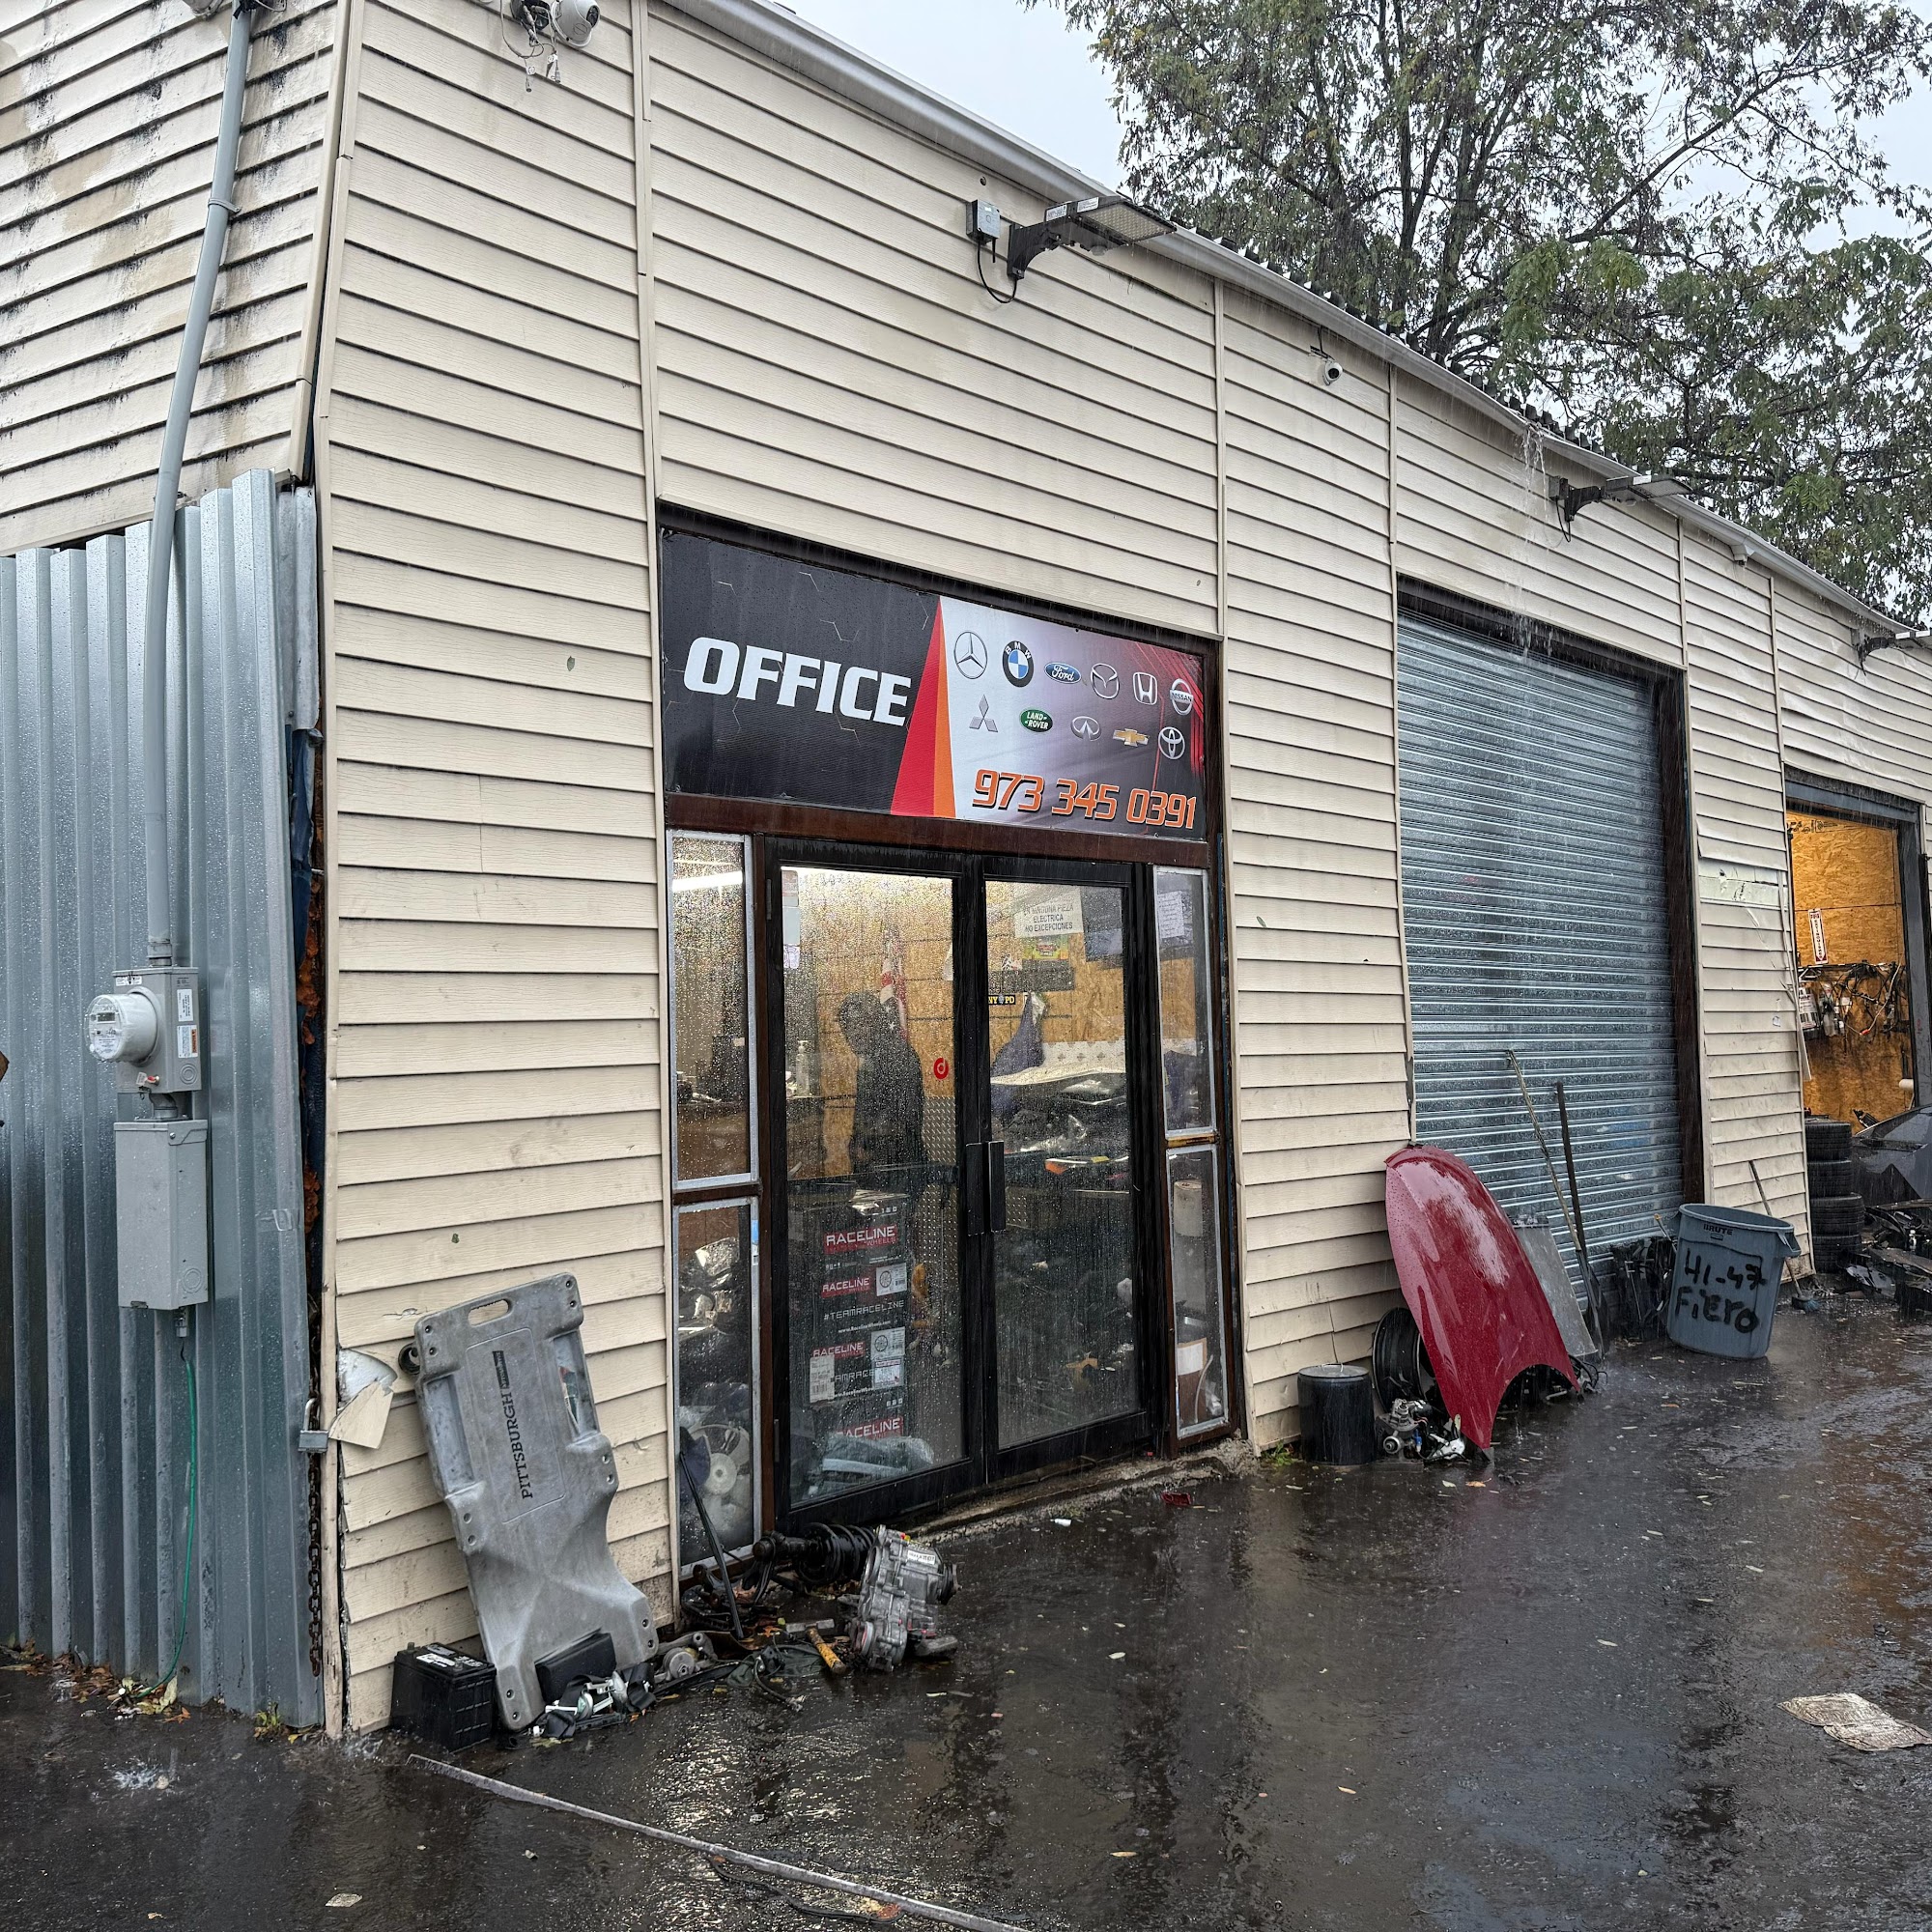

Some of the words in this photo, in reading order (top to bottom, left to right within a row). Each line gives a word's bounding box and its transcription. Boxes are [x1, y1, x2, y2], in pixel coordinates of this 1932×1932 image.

[1005, 641, 1032, 659] BMW
[1052, 664, 1075, 681] Ford
[683, 637, 912, 726] OFFICE
[1170, 691, 1193, 703] NISSAN
[1027, 711, 1044, 721] LAND
[1028, 720, 1049, 730] ROVER
[972, 769, 1044, 811] 973
[1051, 779, 1120, 820] 345
[1126, 788, 1197, 830] 0391
[1033, 914, 1064, 923] ELECTRICA
[1034, 922, 1073, 932] EXCEPCIONES
[826, 1226, 895, 1246] RACELINE
[1703, 1223, 1734, 1236] BRUTE
[822, 1277, 870, 1293] RACELINE
[824, 1300, 904, 1321] #TEAMRACELINE
[812, 1341, 865, 1357] RACELINE
[837, 1417, 901, 1437] ACELINE
[500, 1391, 533, 1499] PITTSBURGH
